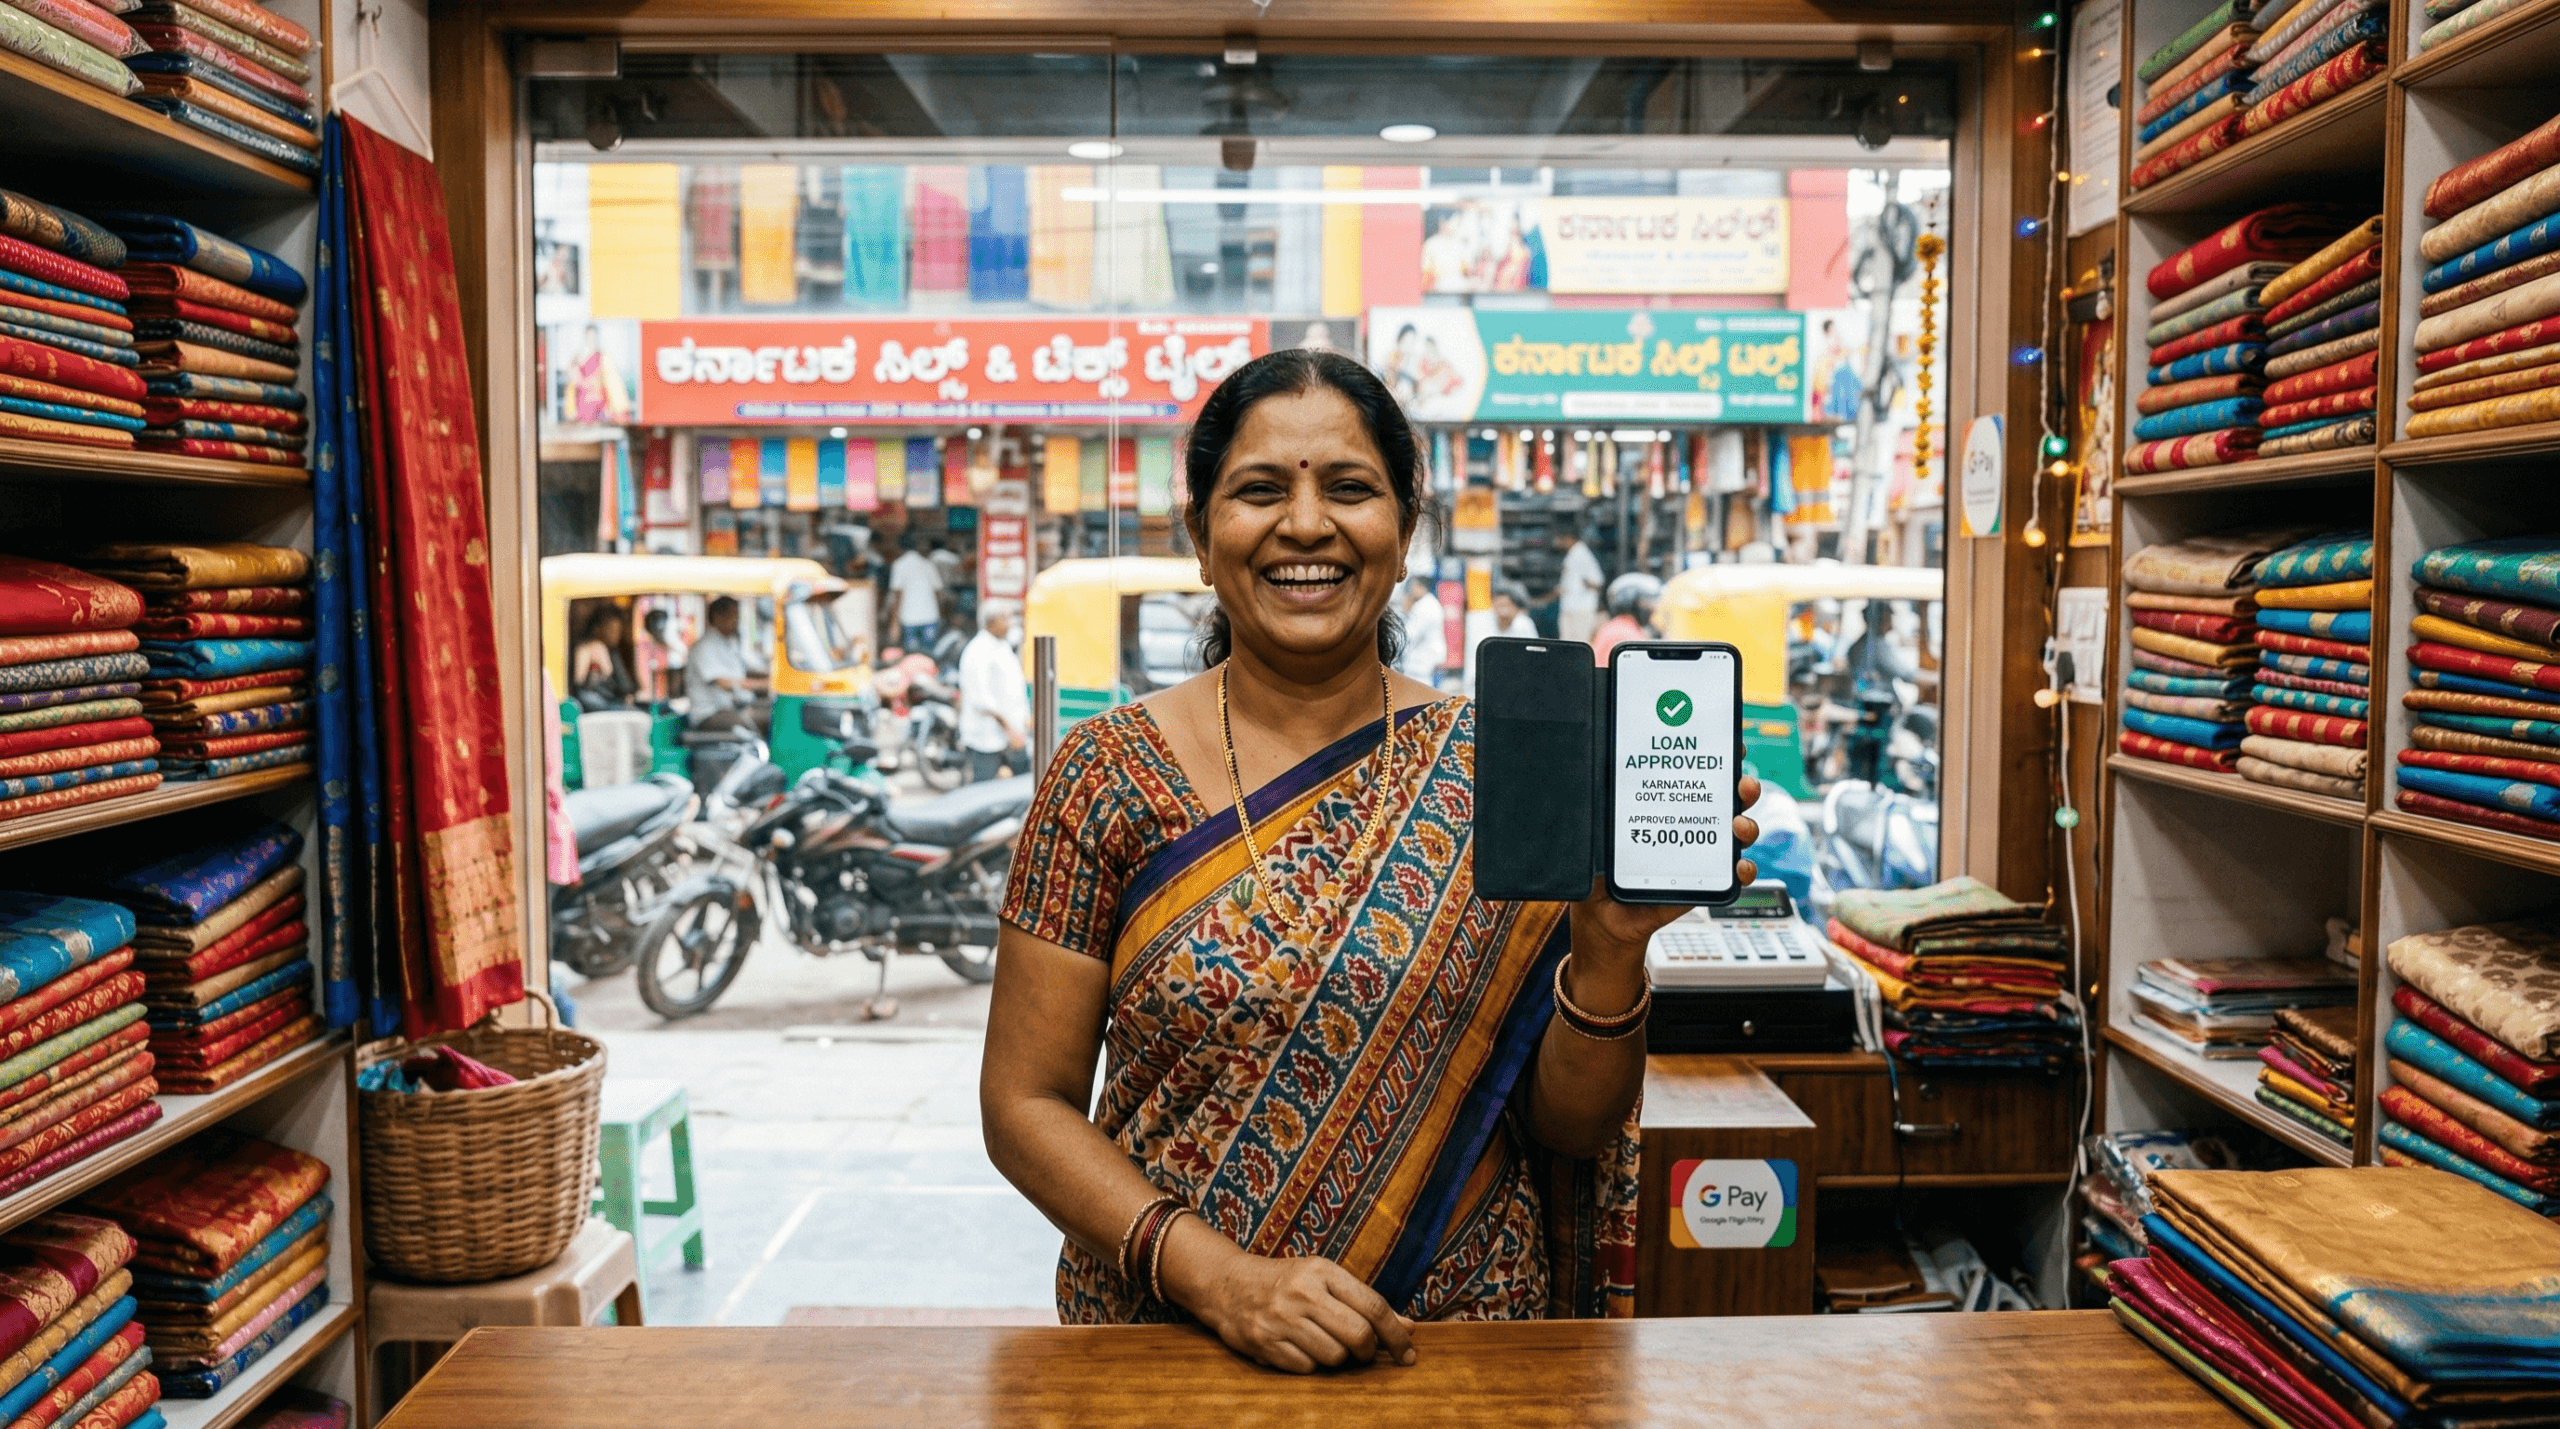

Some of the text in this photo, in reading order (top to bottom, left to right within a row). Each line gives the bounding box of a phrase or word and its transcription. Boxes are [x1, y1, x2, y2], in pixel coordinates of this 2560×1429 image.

[656, 335, 857, 383] ಕರ್ನಾಟಕ
[985, 343, 1018, 382] &
[1493, 334, 1645, 376] ಕರ್ನಾಟಕ
[1651, 736, 1697, 750] LOAN
[1625, 755, 1723, 770] APPROVED!
[1642, 780, 1706, 790] KARNATAKA
[1635, 792, 1713, 802] GOVT. SCHEME
[1628, 816, 1720, 825] APPROVED AMOUNT:
[1630, 829, 1717, 847] ₹5,00,000
[1699, 1185, 1768, 1212] G Pay
